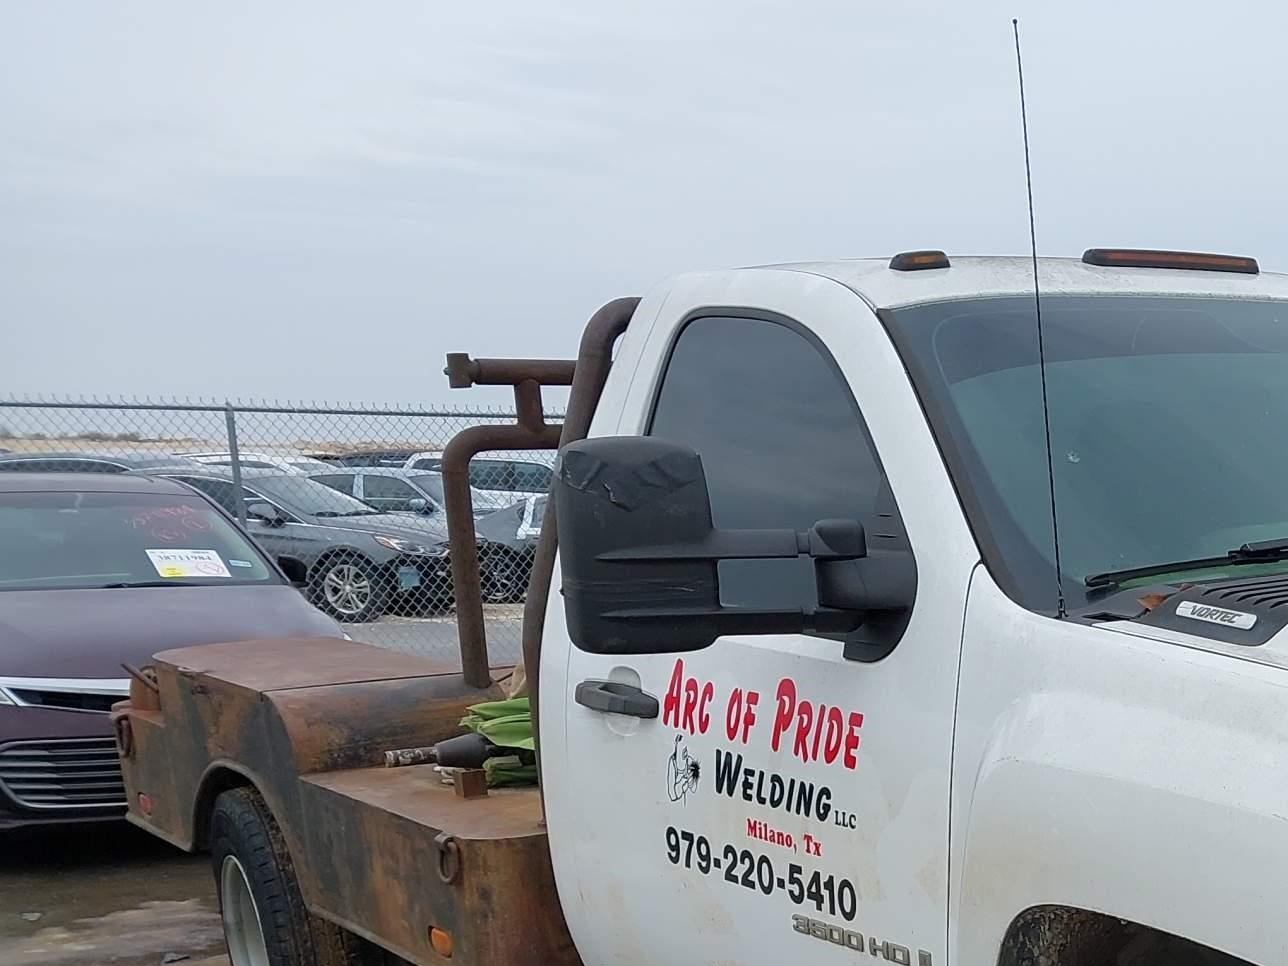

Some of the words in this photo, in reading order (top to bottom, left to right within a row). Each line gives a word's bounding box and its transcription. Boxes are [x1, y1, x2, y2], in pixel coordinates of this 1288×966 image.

[1190, 605, 1243, 624] VORTEC
[663, 658, 714, 736] ARC
[726, 687, 760, 744] OF
[771, 678, 864, 769] PRIDE
[715, 749, 832, 821] WELDING
[834, 810, 857, 829] LLC
[746, 818, 798, 854] Milano,
[803, 834, 822, 857] Tx
[664, 826, 857, 921] 979-220-5410
[791, 913, 865, 953] 3500
[868, 936, 911, 966] HD
